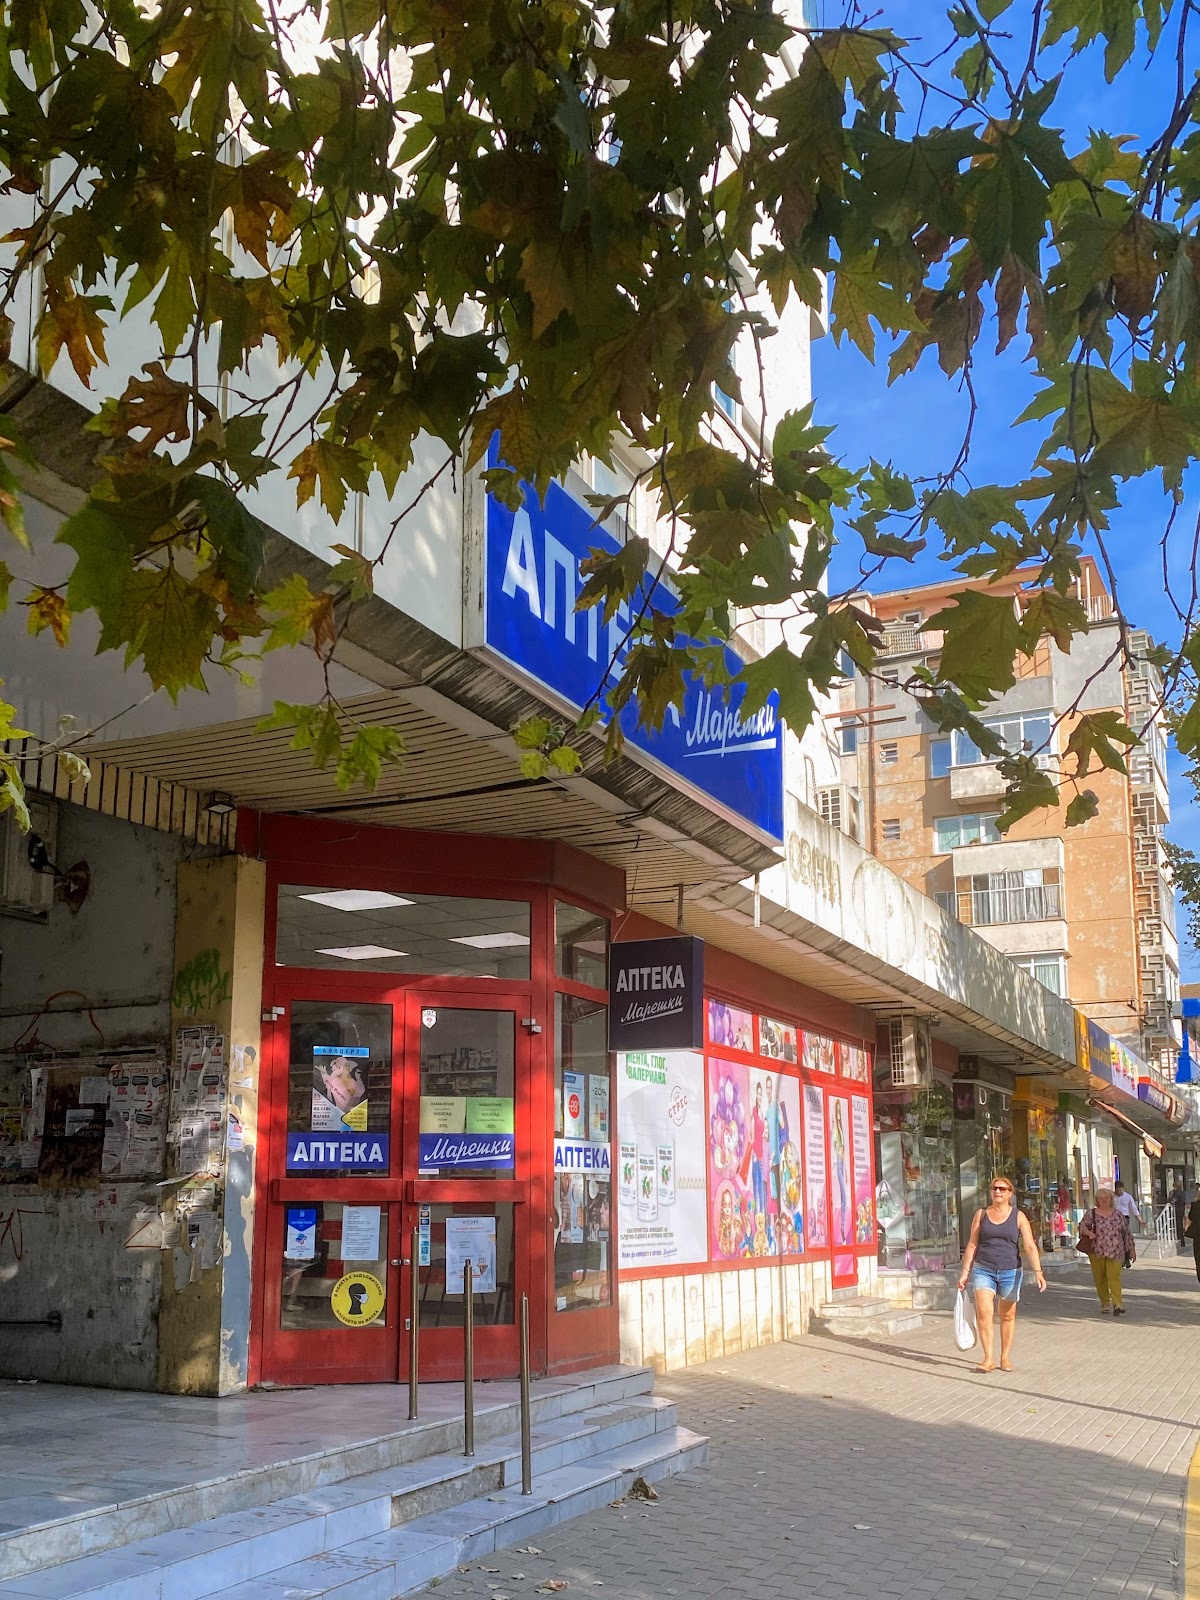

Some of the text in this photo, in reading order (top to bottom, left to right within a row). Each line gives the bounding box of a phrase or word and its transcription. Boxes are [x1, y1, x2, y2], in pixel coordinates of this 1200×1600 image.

[616, 965, 685, 992] АПТЕКА
[620, 996, 683, 1025] Марешки
[628, 1066, 666, 1085] ВАЛЕРИАНА
[668, 1096, 688, 1119] СТРЕС
[293, 1142, 384, 1162] АПТЕКА
[422, 1138, 511, 1165] Марешки
[554, 1145, 610, 1168] АПТЕКА
